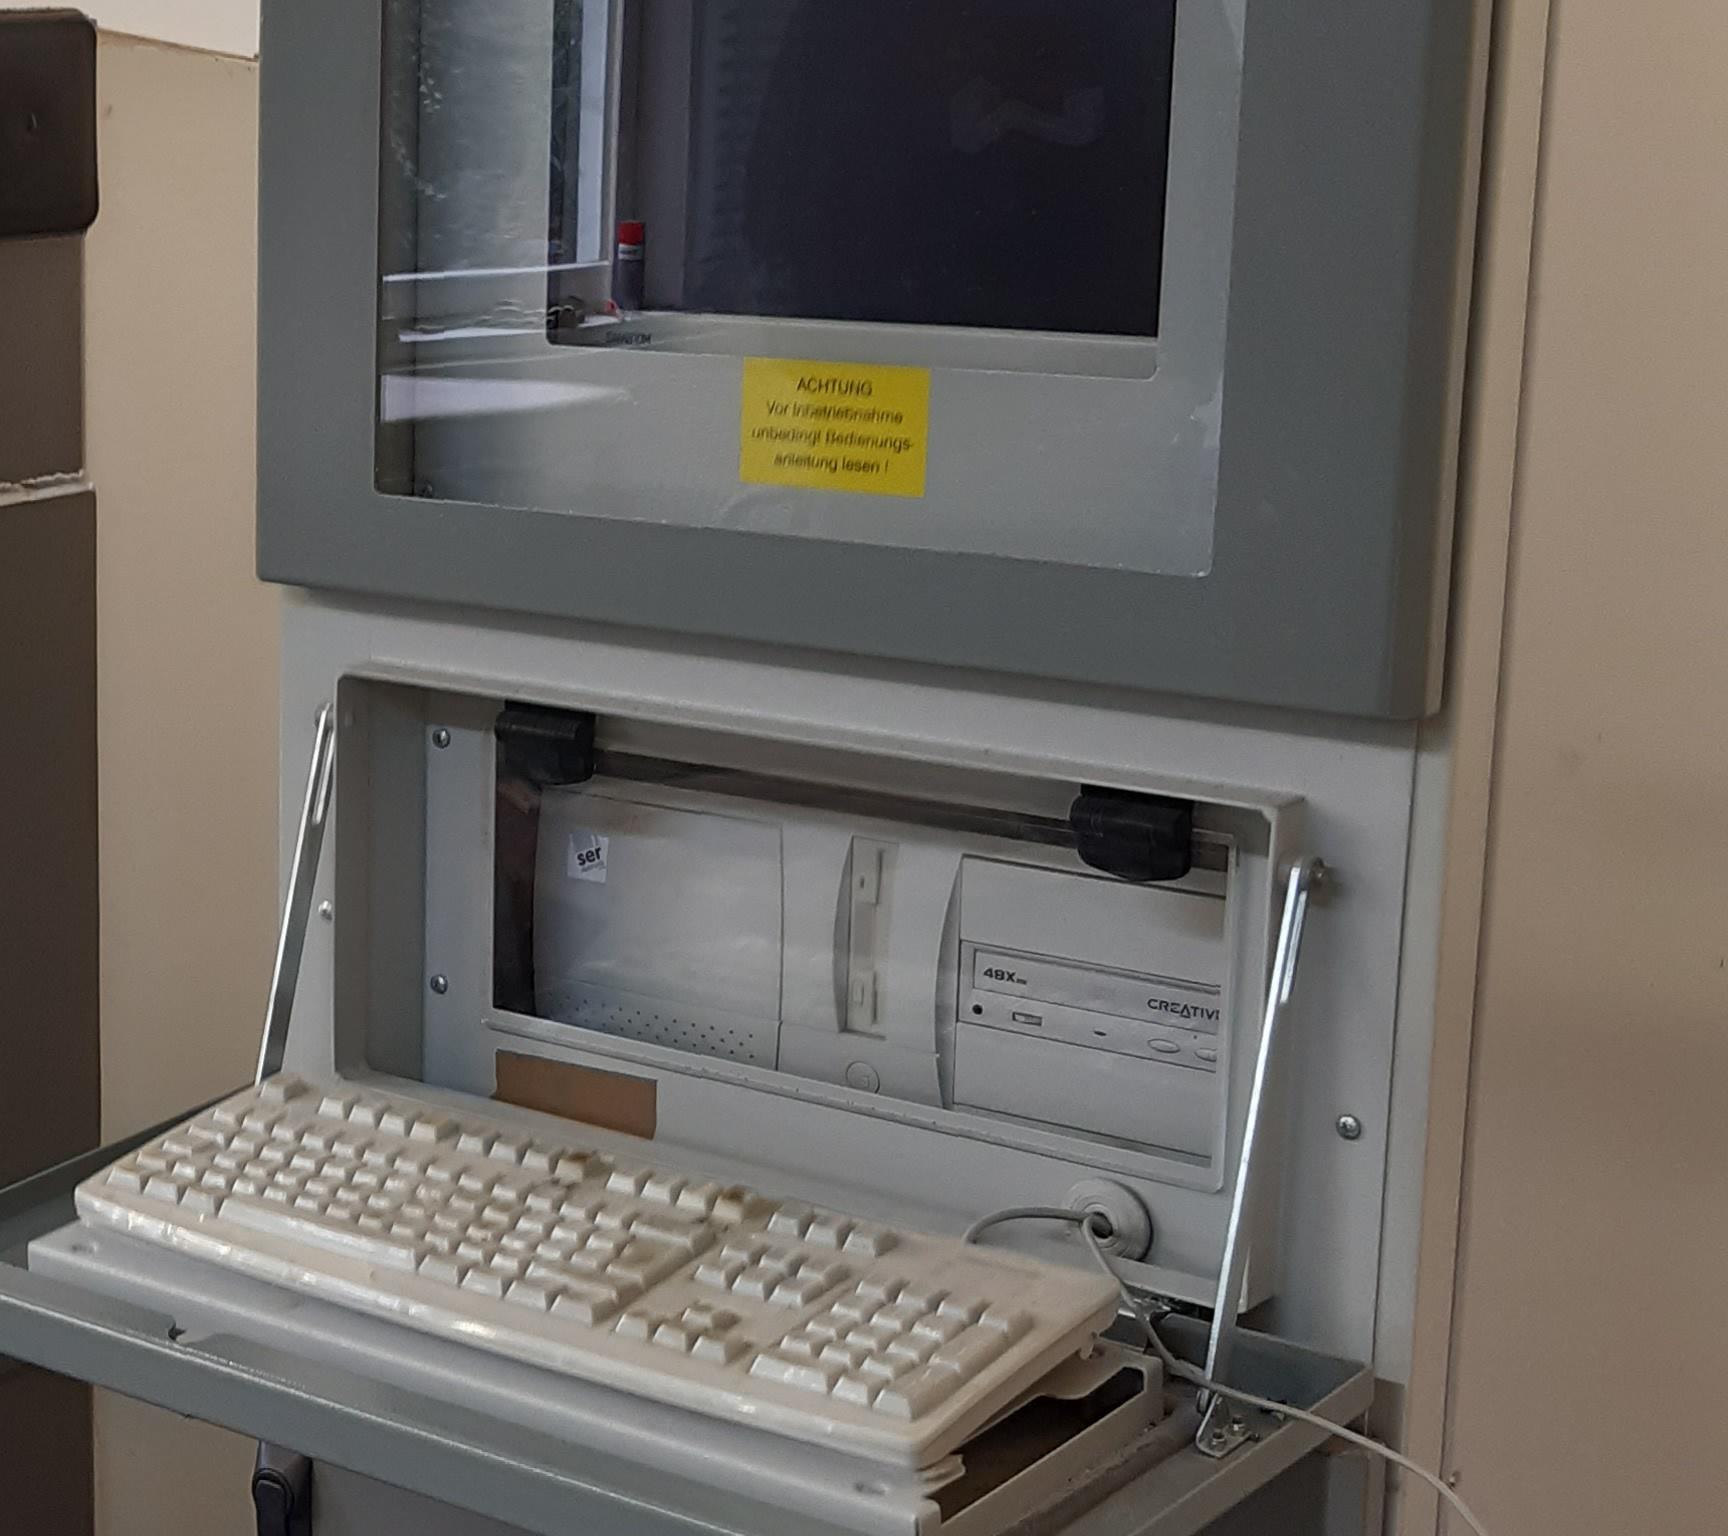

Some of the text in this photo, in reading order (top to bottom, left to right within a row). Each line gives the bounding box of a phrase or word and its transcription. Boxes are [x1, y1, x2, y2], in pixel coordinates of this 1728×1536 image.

[797, 376, 873, 397] ACHTUNG
[766, 400, 790, 417] Vor
[751, 426, 913, 454] unbedingt Bedienungs-
[773, 452, 838, 474] anleitung
[841, 457, 880, 474] lesen
[576, 846, 602, 867] ser
